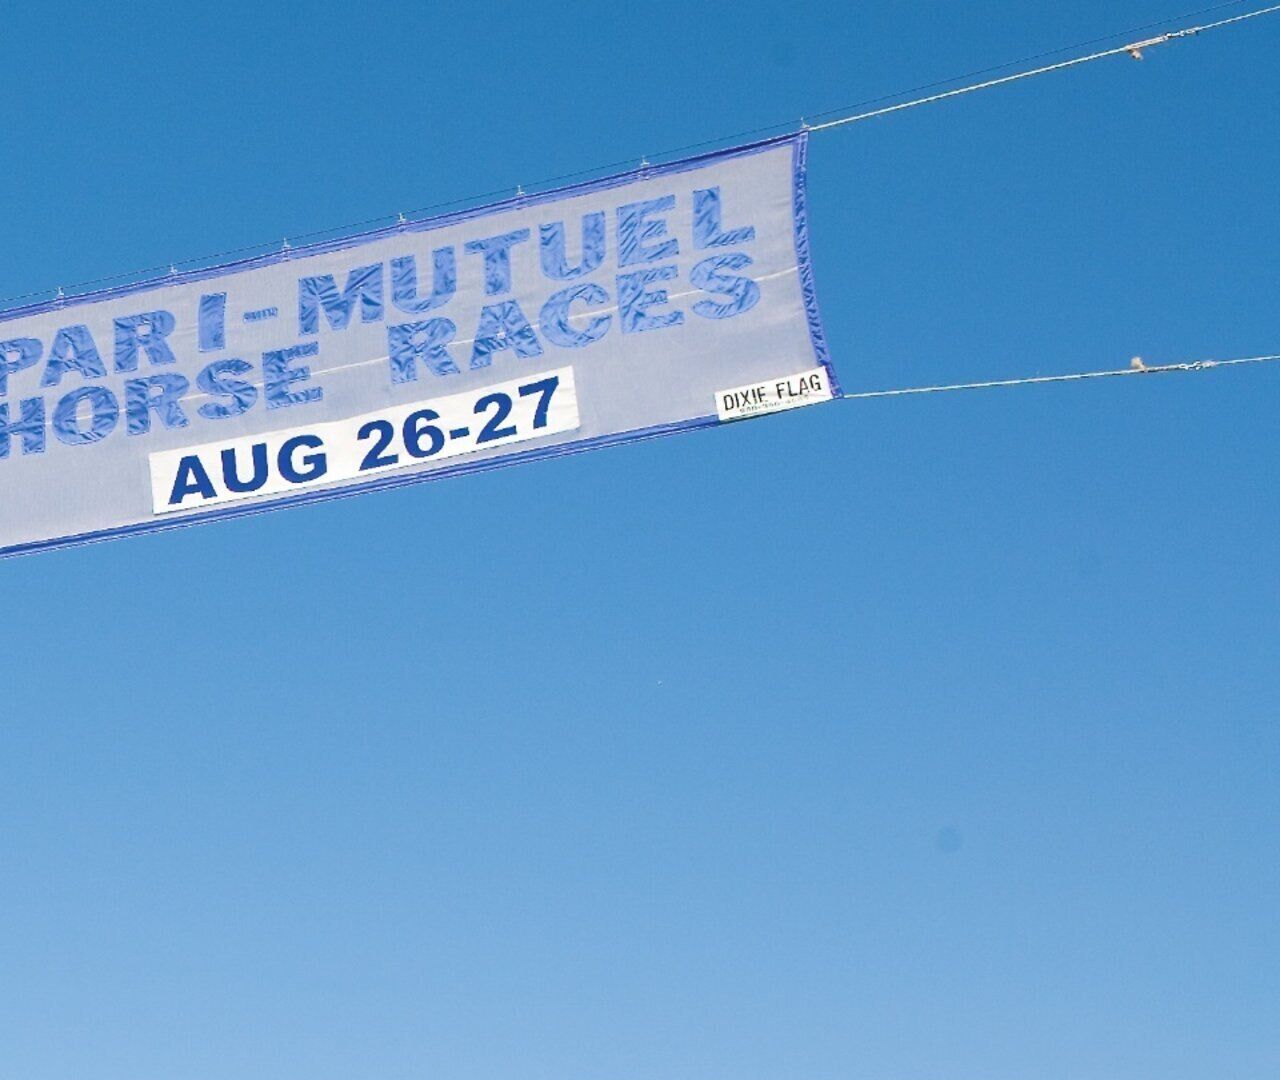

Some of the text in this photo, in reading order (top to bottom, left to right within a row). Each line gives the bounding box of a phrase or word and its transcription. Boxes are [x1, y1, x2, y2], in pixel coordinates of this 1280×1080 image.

[387, 251, 760, 383] RACES
[168, 376, 560, 503] AUG 26-27
[775, 374, 822, 400] FLAG
